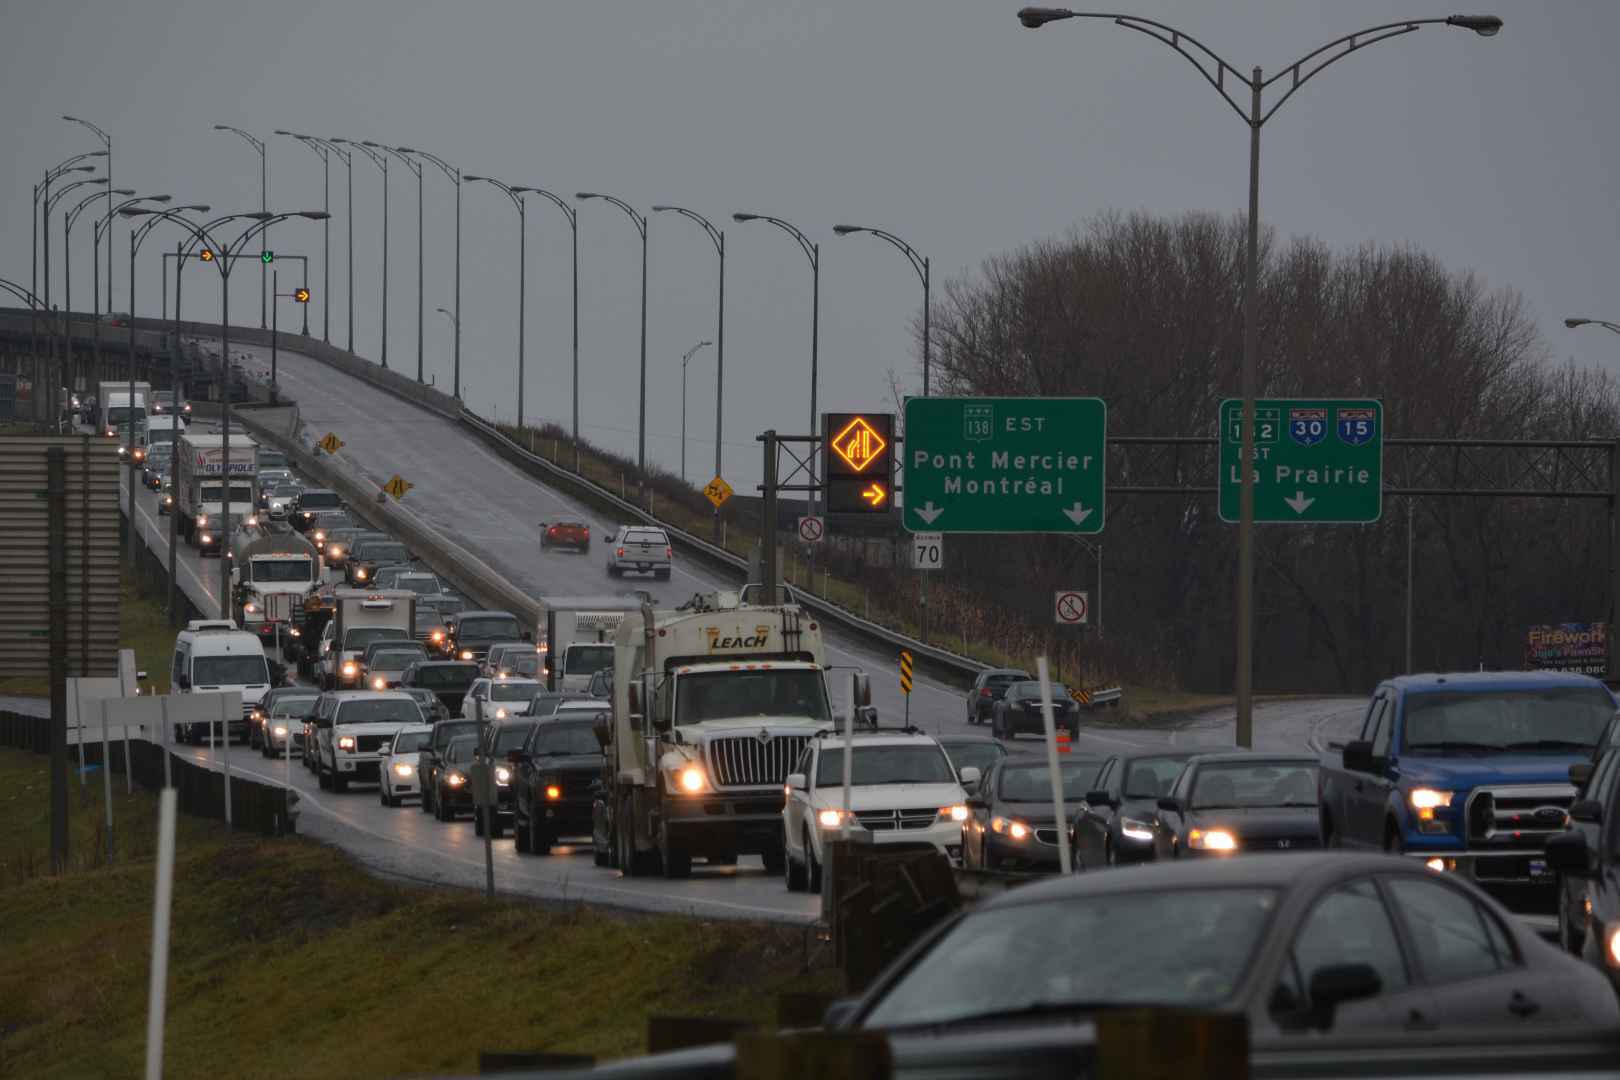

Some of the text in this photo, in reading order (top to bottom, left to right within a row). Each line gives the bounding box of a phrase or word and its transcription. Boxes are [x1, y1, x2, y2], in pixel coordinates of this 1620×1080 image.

[967, 417, 1046, 435] 138 EST
[1233, 424, 1272, 438] 12
[1295, 421, 1322, 436] 30
[1344, 421, 1368, 436] 15
[913, 450, 1094, 470] Pont Mercier
[1275, 464, 1370, 484] Prairie
[943, 475, 1064, 495] Montréal
[916, 545, 940, 563] 70
[711, 636, 768, 649] LEACH
